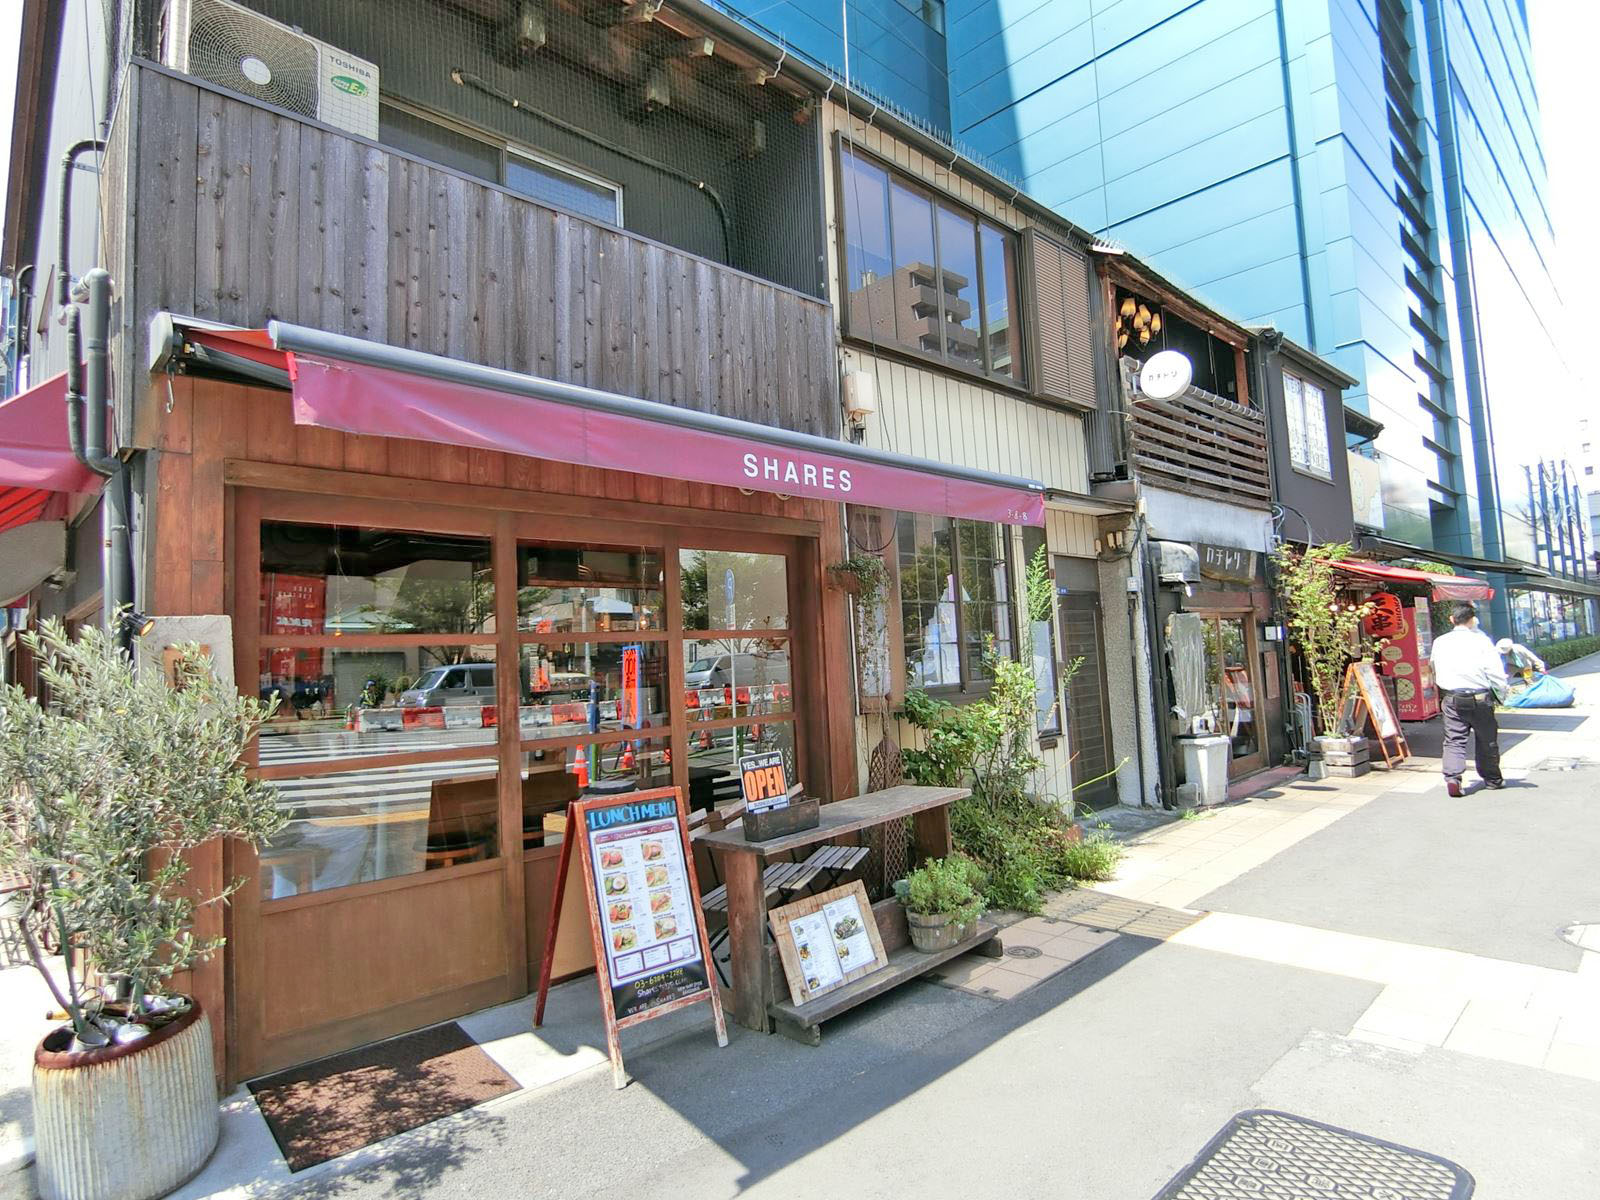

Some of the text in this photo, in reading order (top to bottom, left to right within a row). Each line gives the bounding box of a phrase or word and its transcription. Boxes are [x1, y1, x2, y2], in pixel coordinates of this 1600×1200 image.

[330, 55, 371, 79] TOSHIBA
[743, 453, 852, 492] SHARES
[744, 766, 785, 801] OPEN
[590, 800, 677, 829] LUNCH MENU
